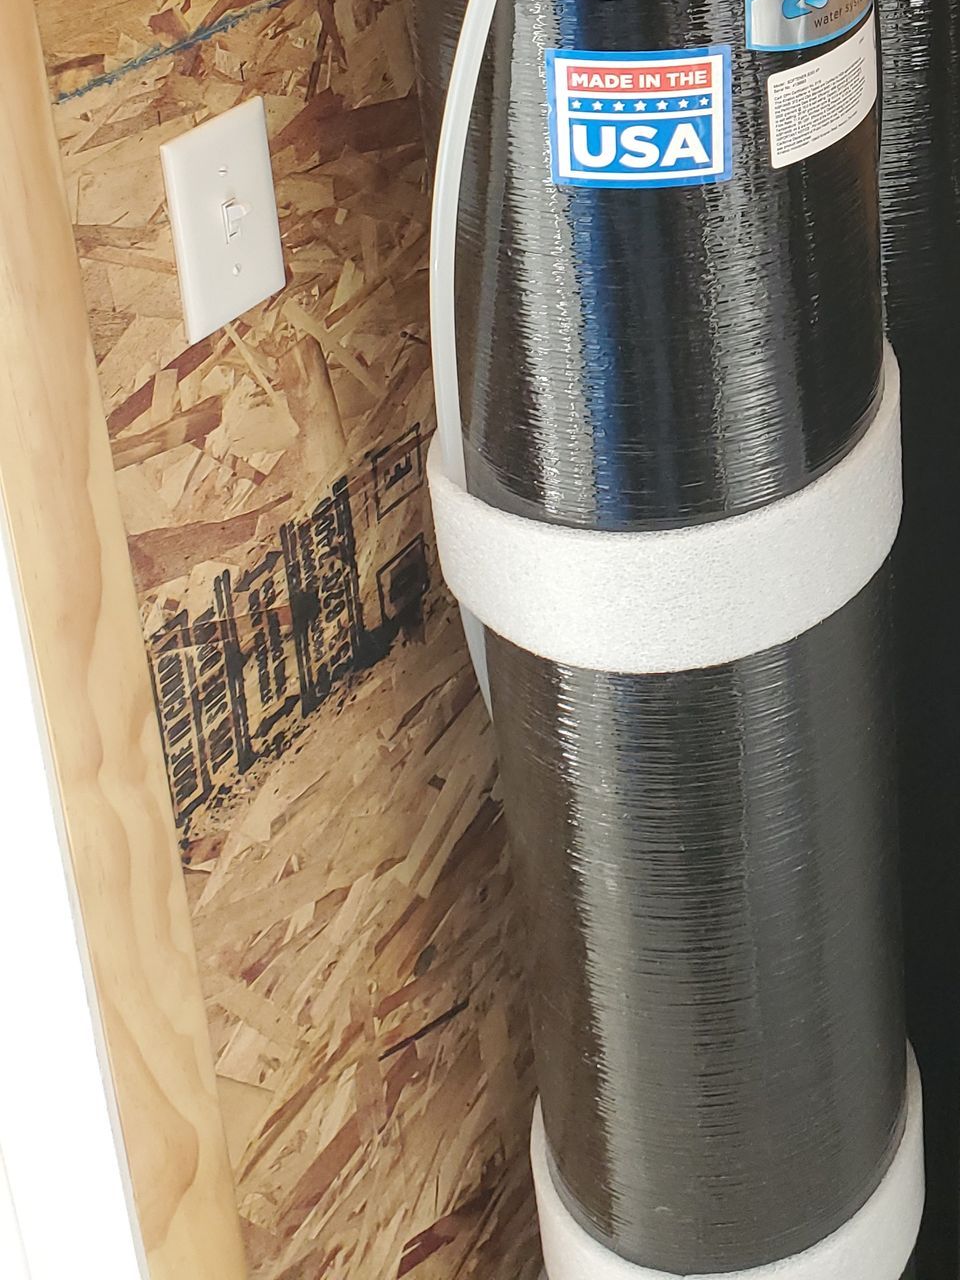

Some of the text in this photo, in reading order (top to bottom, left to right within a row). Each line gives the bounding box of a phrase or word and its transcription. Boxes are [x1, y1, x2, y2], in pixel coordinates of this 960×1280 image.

[814, 7, 843, 29] water
[571, 68, 708, 89] MADE IN THE
[570, 123, 710, 170] USA
